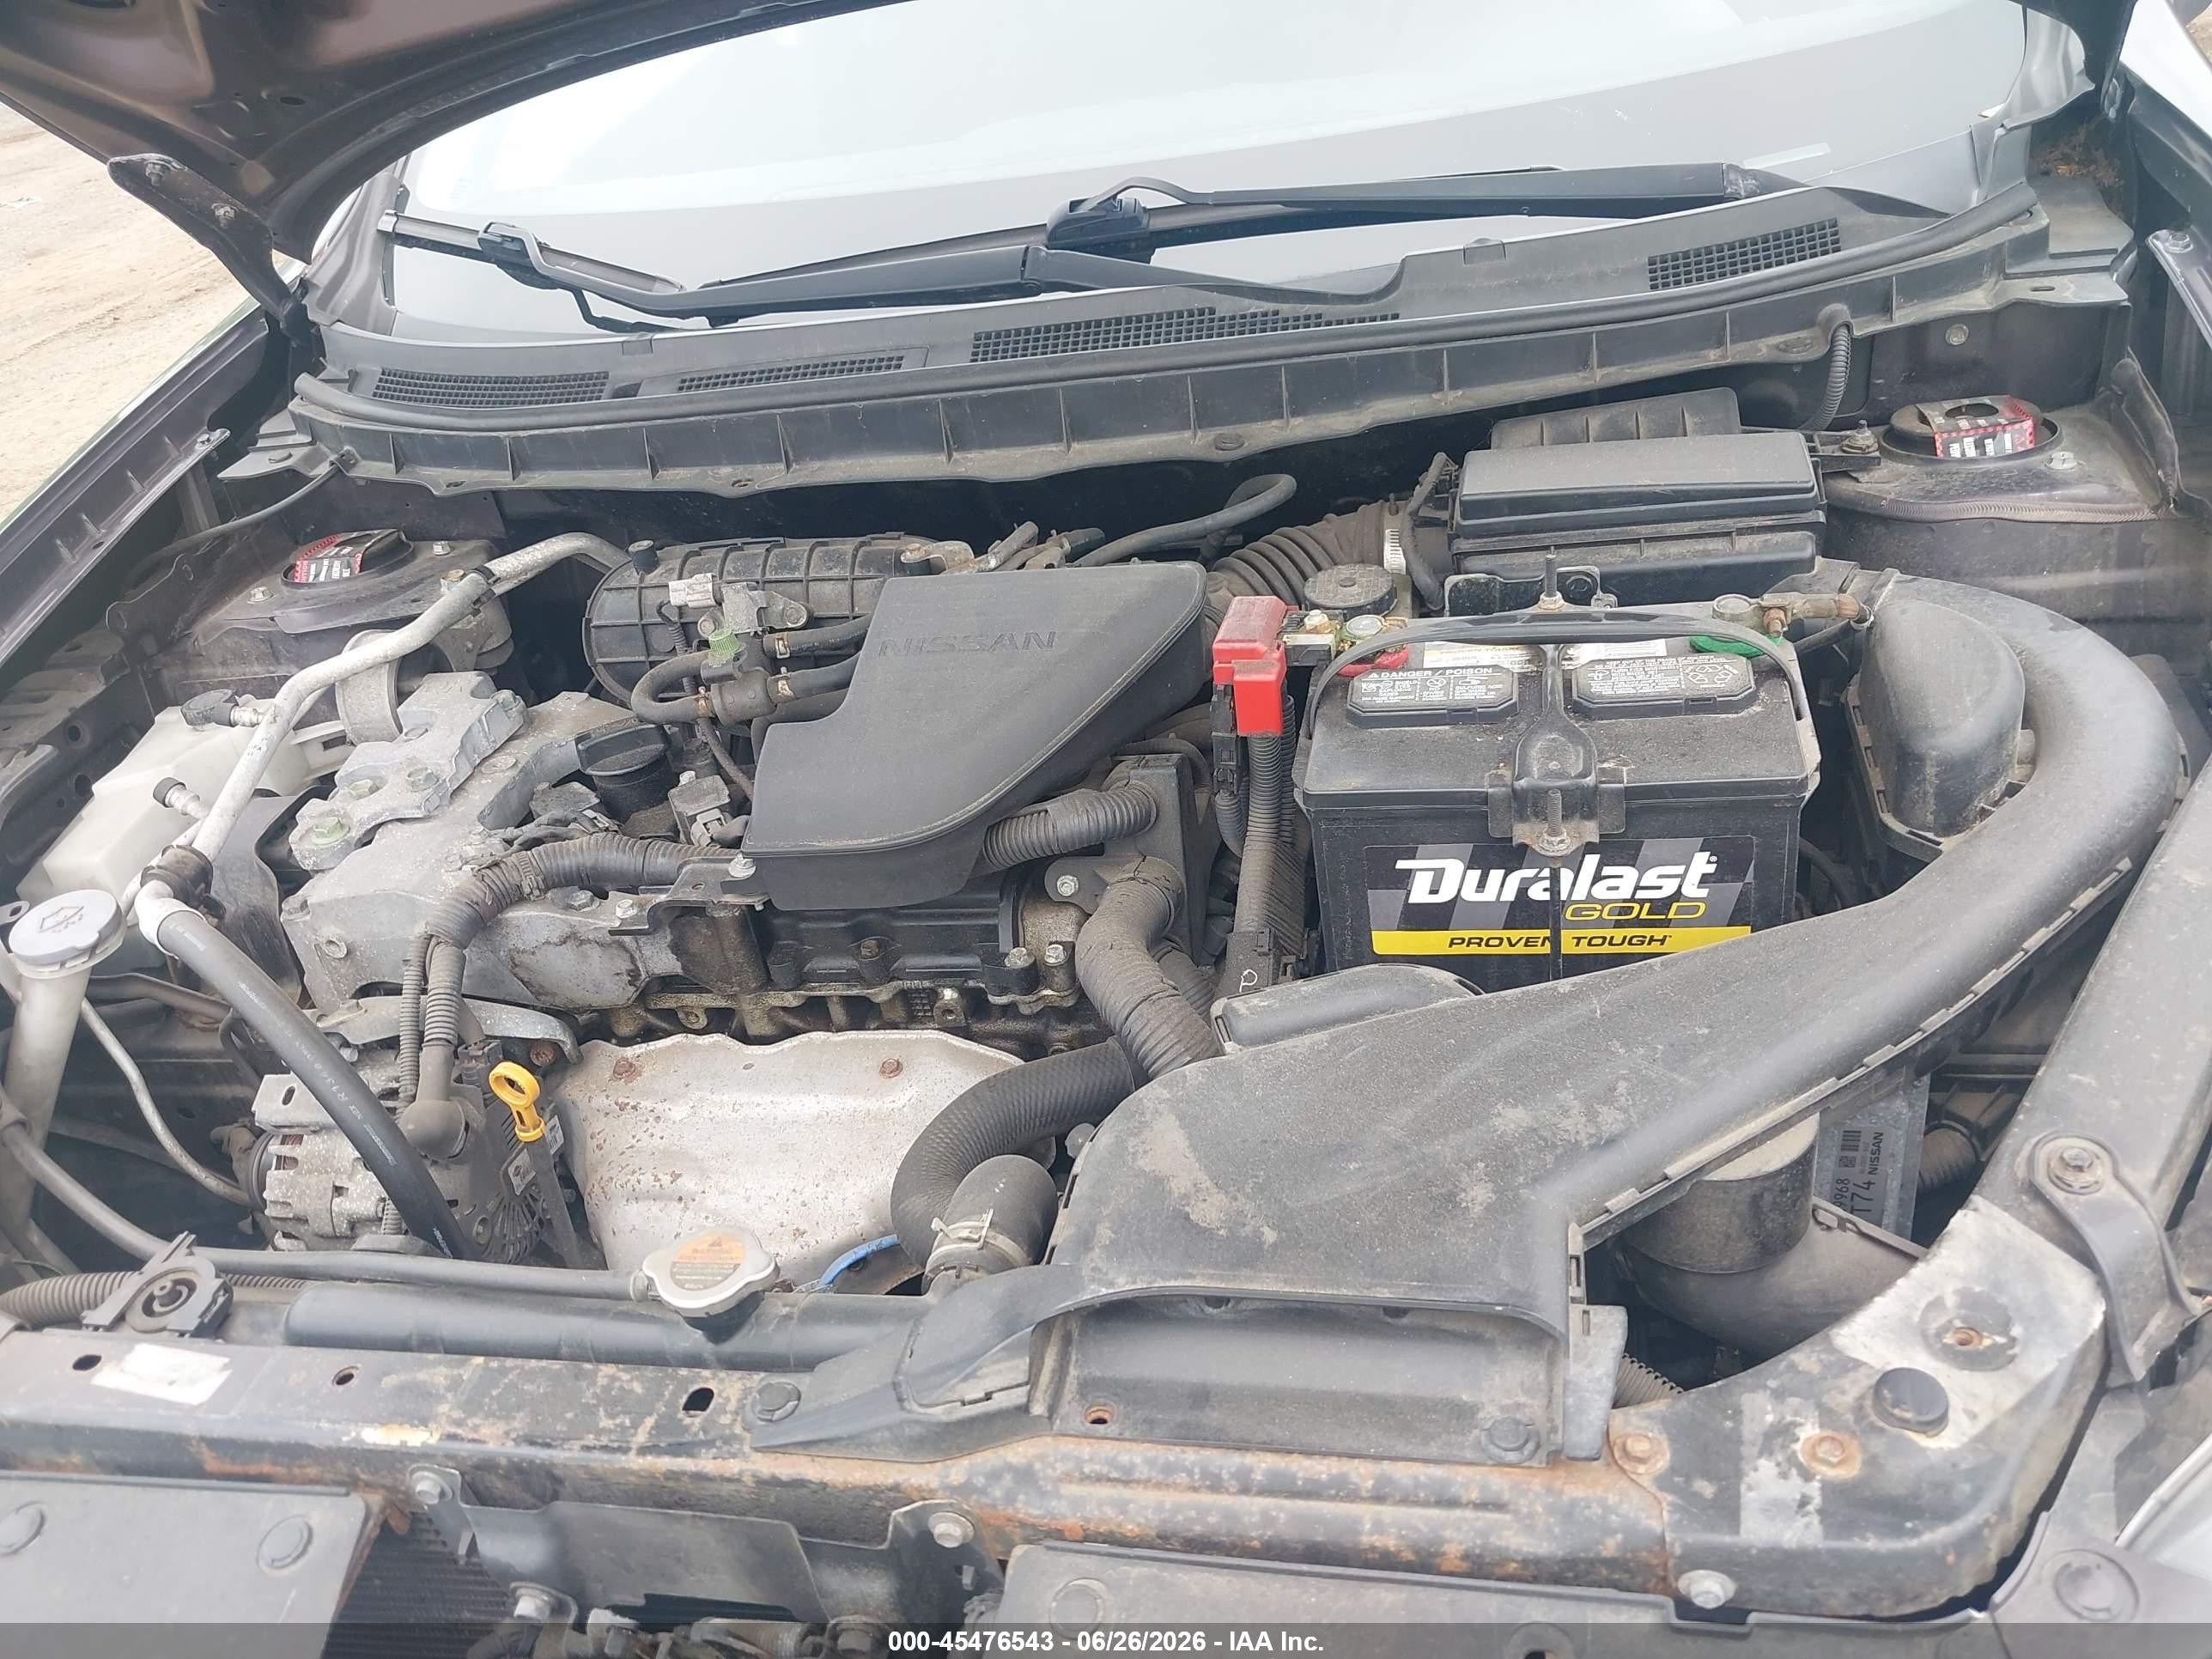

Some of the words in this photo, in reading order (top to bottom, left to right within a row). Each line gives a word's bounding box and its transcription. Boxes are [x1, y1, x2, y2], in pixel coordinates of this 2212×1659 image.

[878, 631, 1056, 657] NISSAN
[1380, 670, 1432, 678] DANGER
[1445, 667, 1492, 676] POISON
[1395, 851, 1717, 903] Duralast
[1565, 902, 1707, 921] GOLD
[1868, 1132, 1884, 1176] NISSAN
